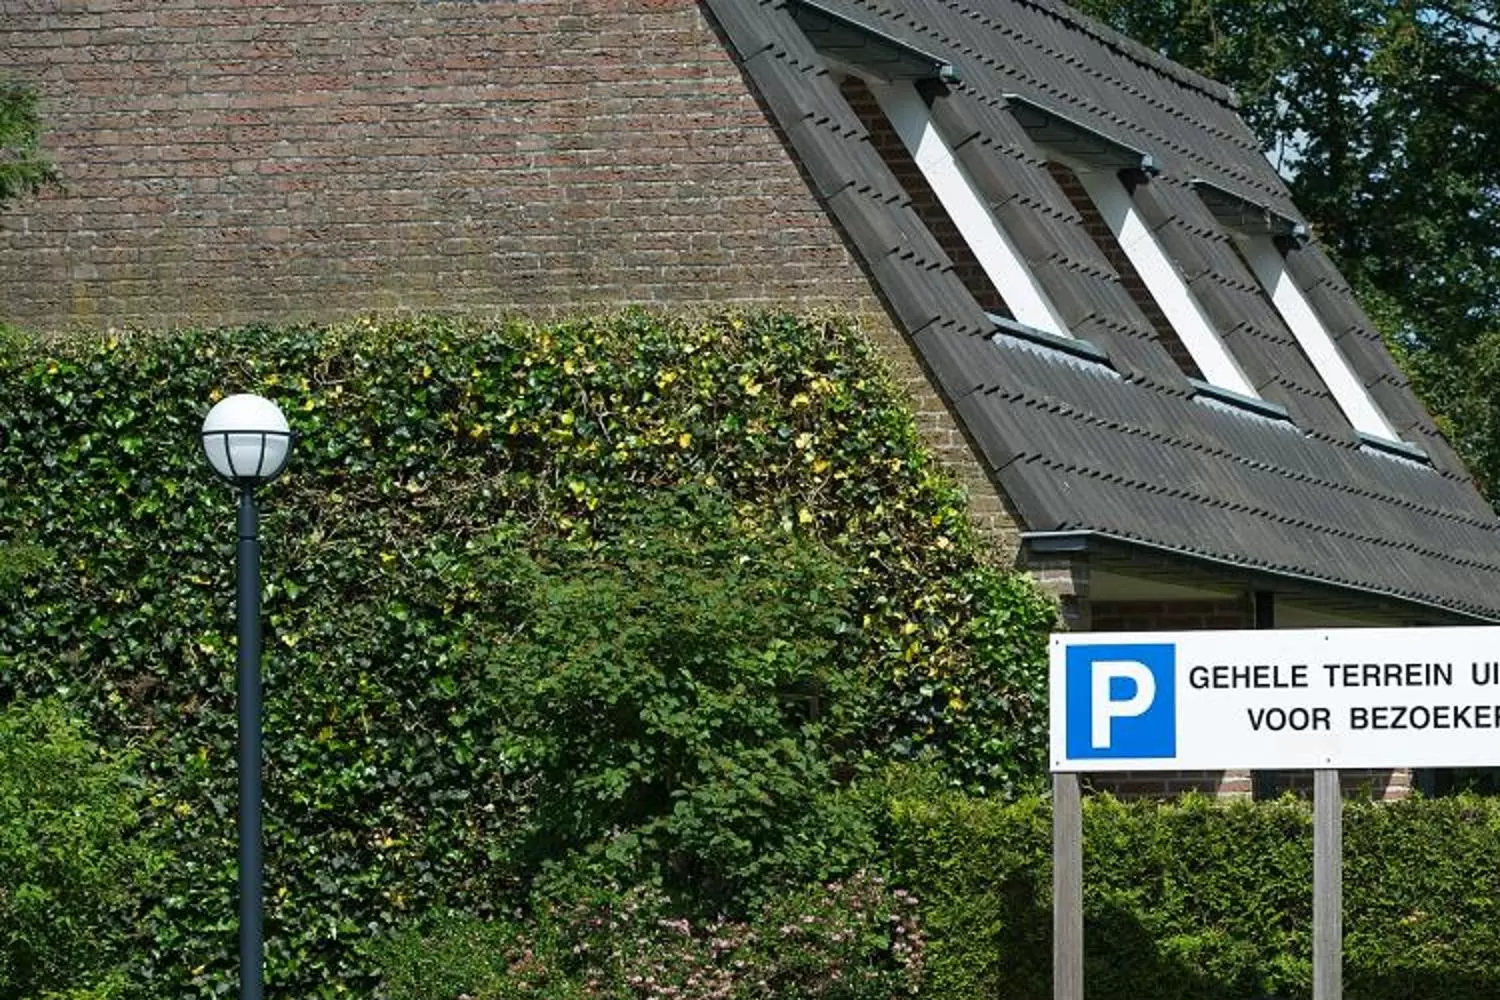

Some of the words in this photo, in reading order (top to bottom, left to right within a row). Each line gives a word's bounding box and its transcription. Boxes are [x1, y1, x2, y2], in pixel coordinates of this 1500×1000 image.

[1189, 665, 1309, 689] GEHELE
[1323, 663, 1453, 688] TERREIN
[1092, 661, 1156, 749] P
[1247, 707, 1331, 732] VOOR
